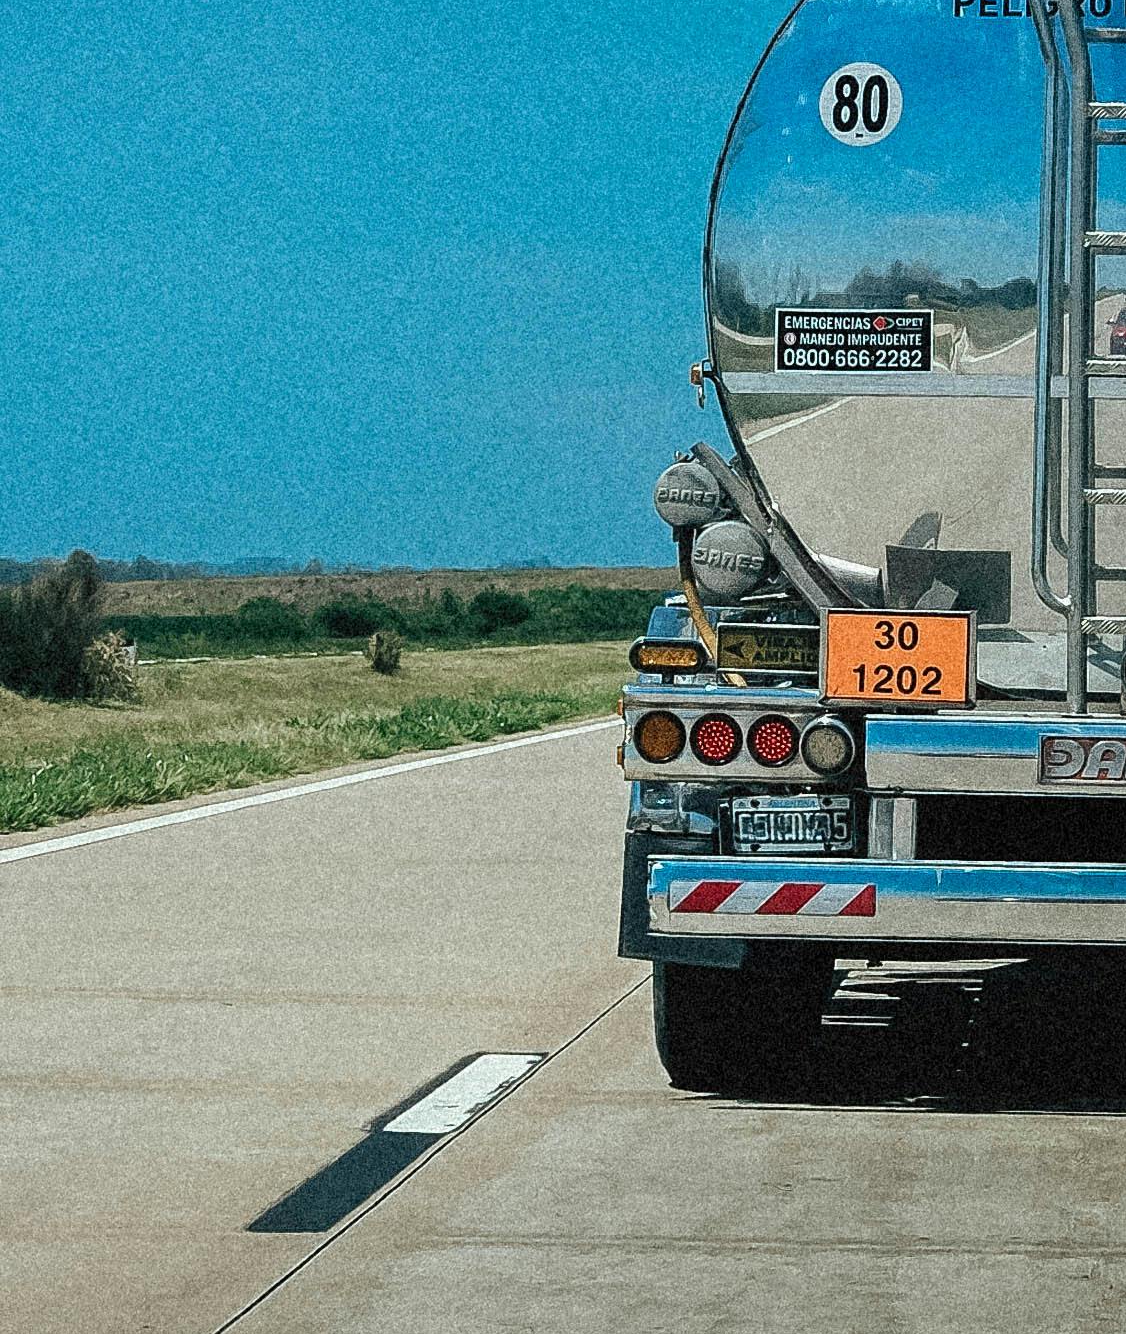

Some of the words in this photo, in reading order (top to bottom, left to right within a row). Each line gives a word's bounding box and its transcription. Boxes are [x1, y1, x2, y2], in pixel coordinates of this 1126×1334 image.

[832, 74, 889, 133] 80
[784, 315, 871, 330] EMERGENCIAS
[799, 332, 845, 346] MANEJO
[847, 333, 922, 346] IMPRUDENTE
[874, 620, 919, 651] 30
[852, 663, 943, 695] 1202
